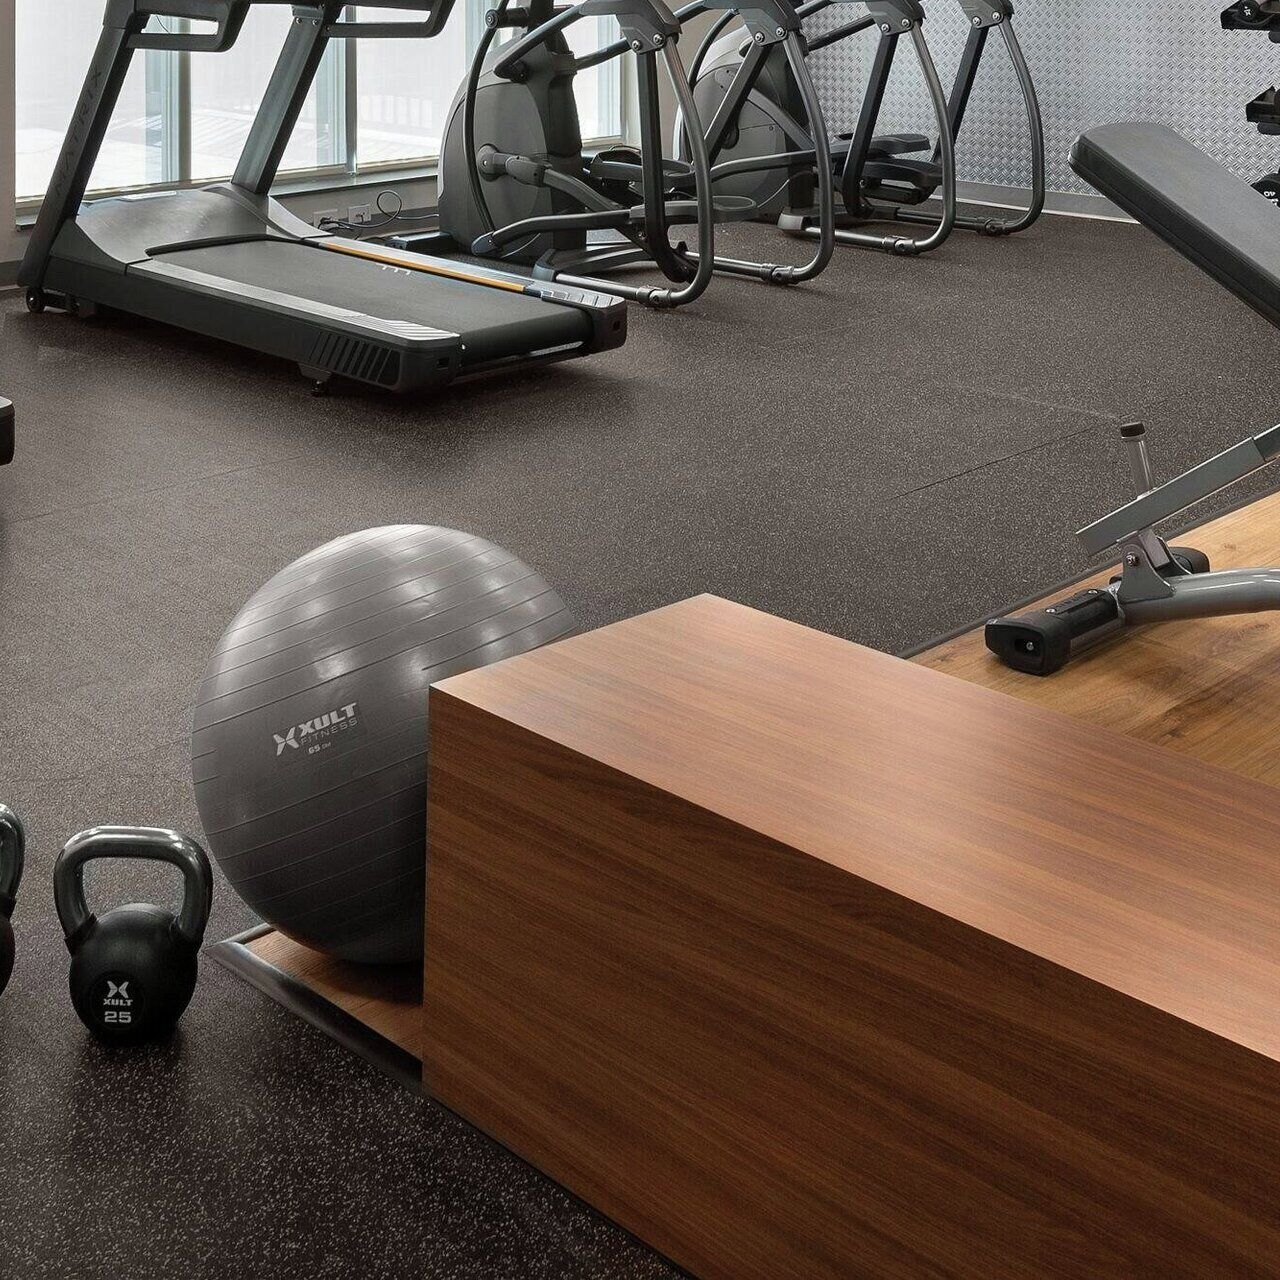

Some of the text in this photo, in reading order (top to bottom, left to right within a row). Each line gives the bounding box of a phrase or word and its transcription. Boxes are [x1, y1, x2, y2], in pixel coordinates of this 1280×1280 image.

[298, 702, 357, 737] XULT
[301, 717, 358, 745] FITNESS
[103, 998, 134, 1007] XULT
[104, 1011, 132, 1023] 25
